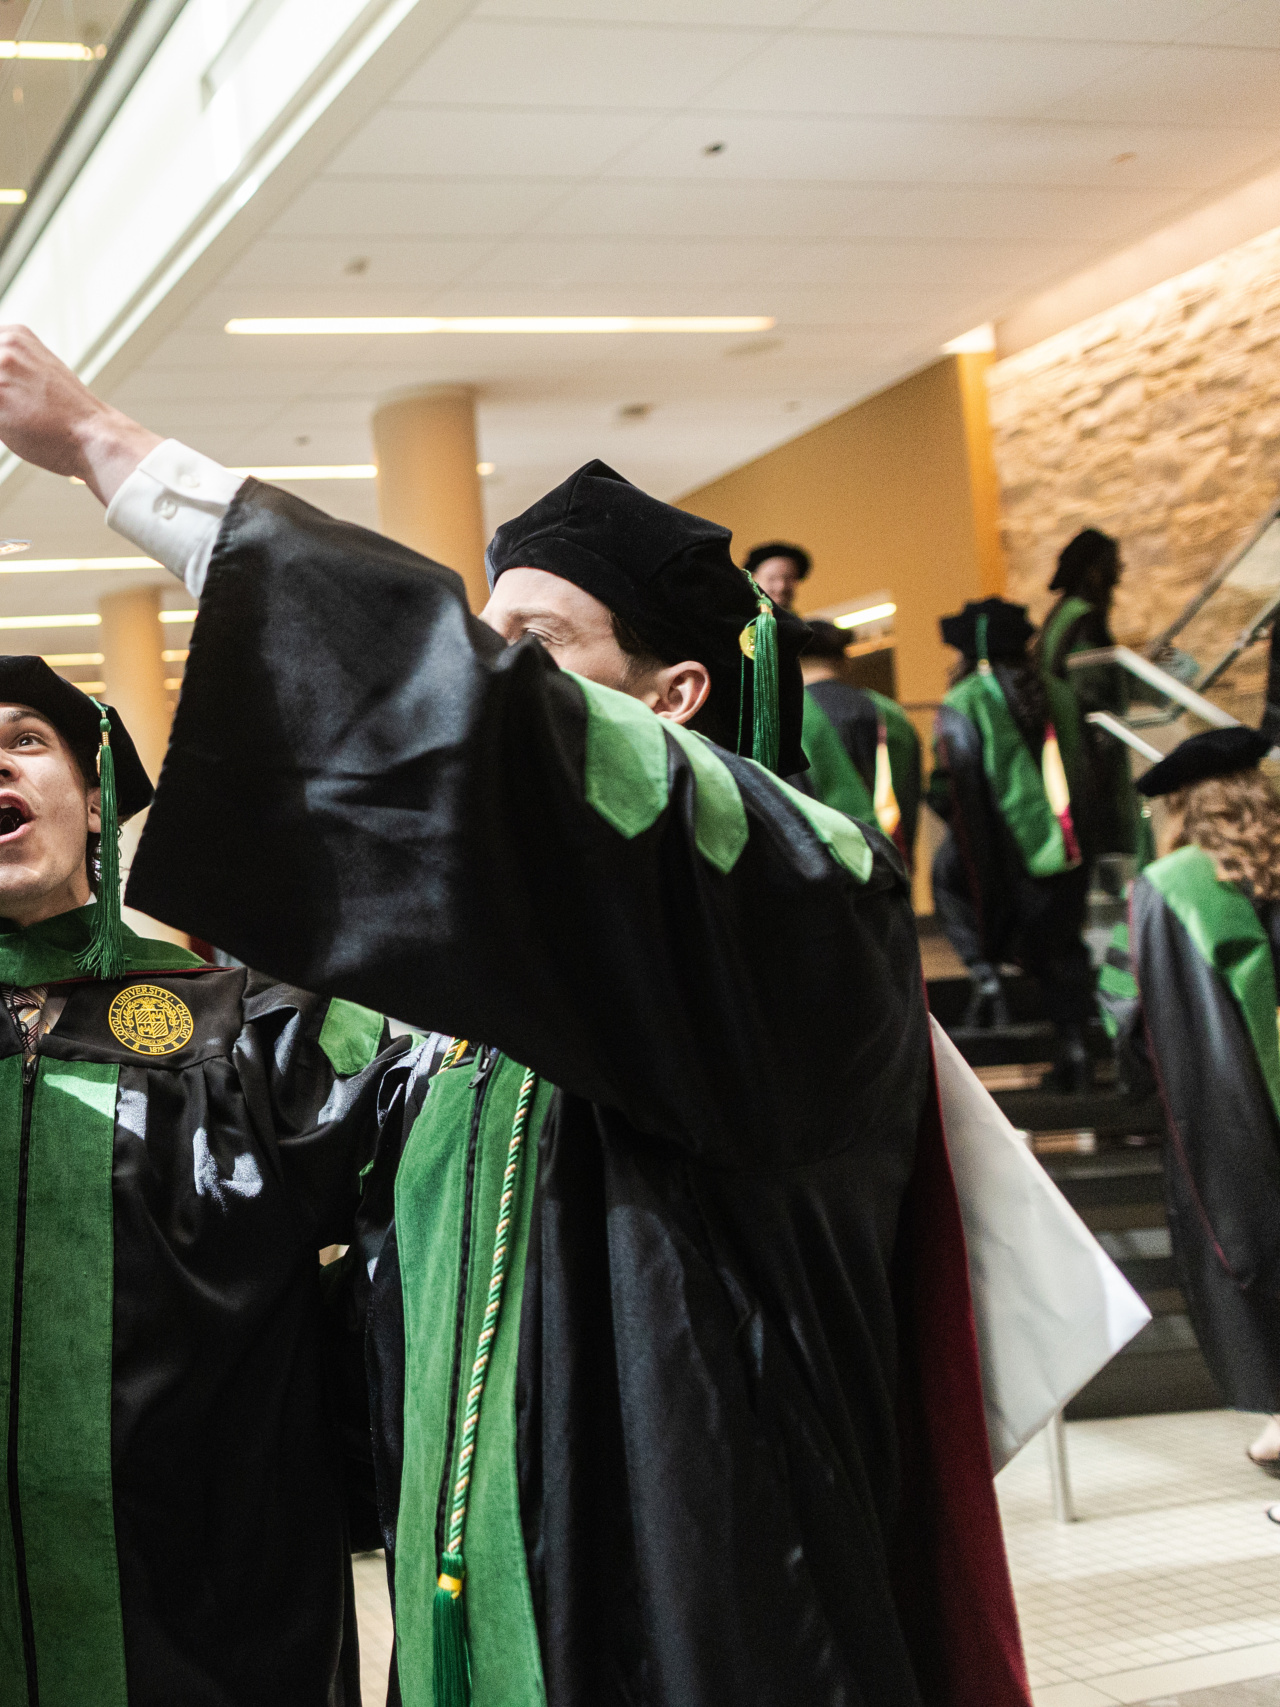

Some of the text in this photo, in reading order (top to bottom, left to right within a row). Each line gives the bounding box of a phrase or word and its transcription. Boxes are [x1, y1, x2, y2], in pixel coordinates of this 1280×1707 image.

[115, 987, 172, 1006] UNIVERSITY
[111, 1008, 129, 1042] LOYOLA
[176, 1003, 191, 1039] CHICAGO
[149, 1045, 166, 1053] 1870
